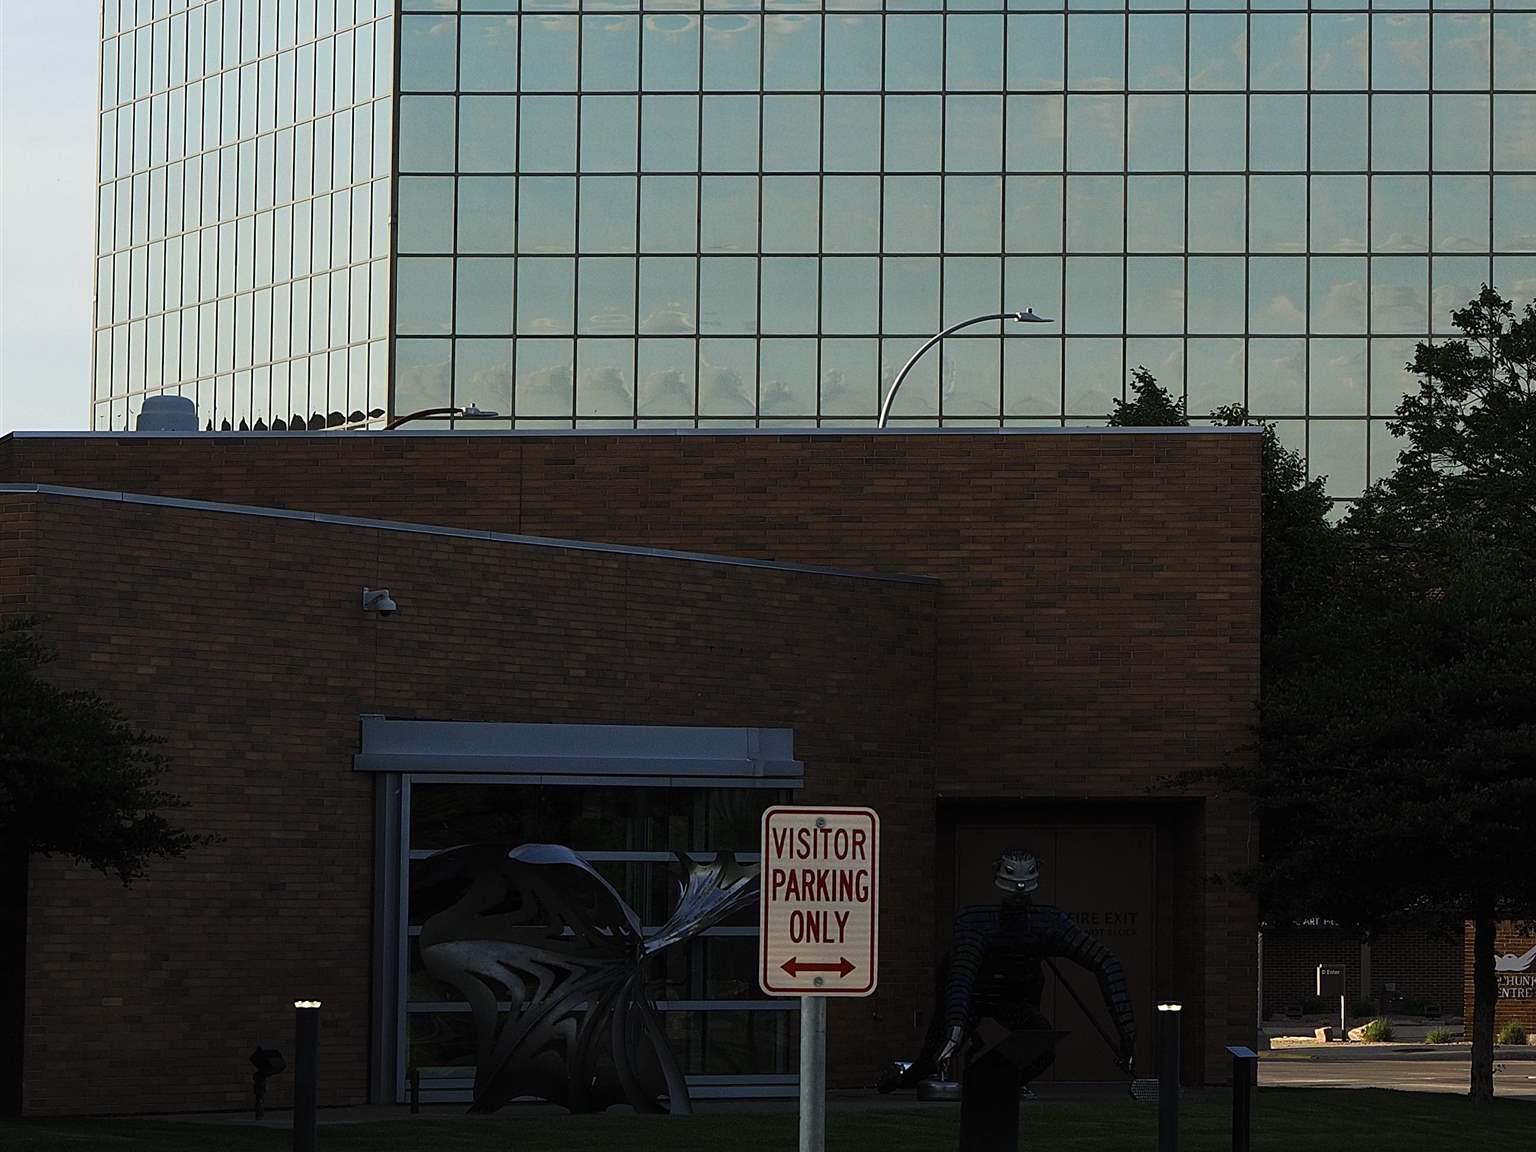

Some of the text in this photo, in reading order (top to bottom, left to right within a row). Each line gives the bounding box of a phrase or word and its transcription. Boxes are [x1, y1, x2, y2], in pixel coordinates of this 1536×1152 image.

[772, 827, 866, 860] VISITOR
[771, 868, 869, 903] PARKING
[789, 910, 850, 944] ONLY
[1105, 912, 1137, 924] EXIT
